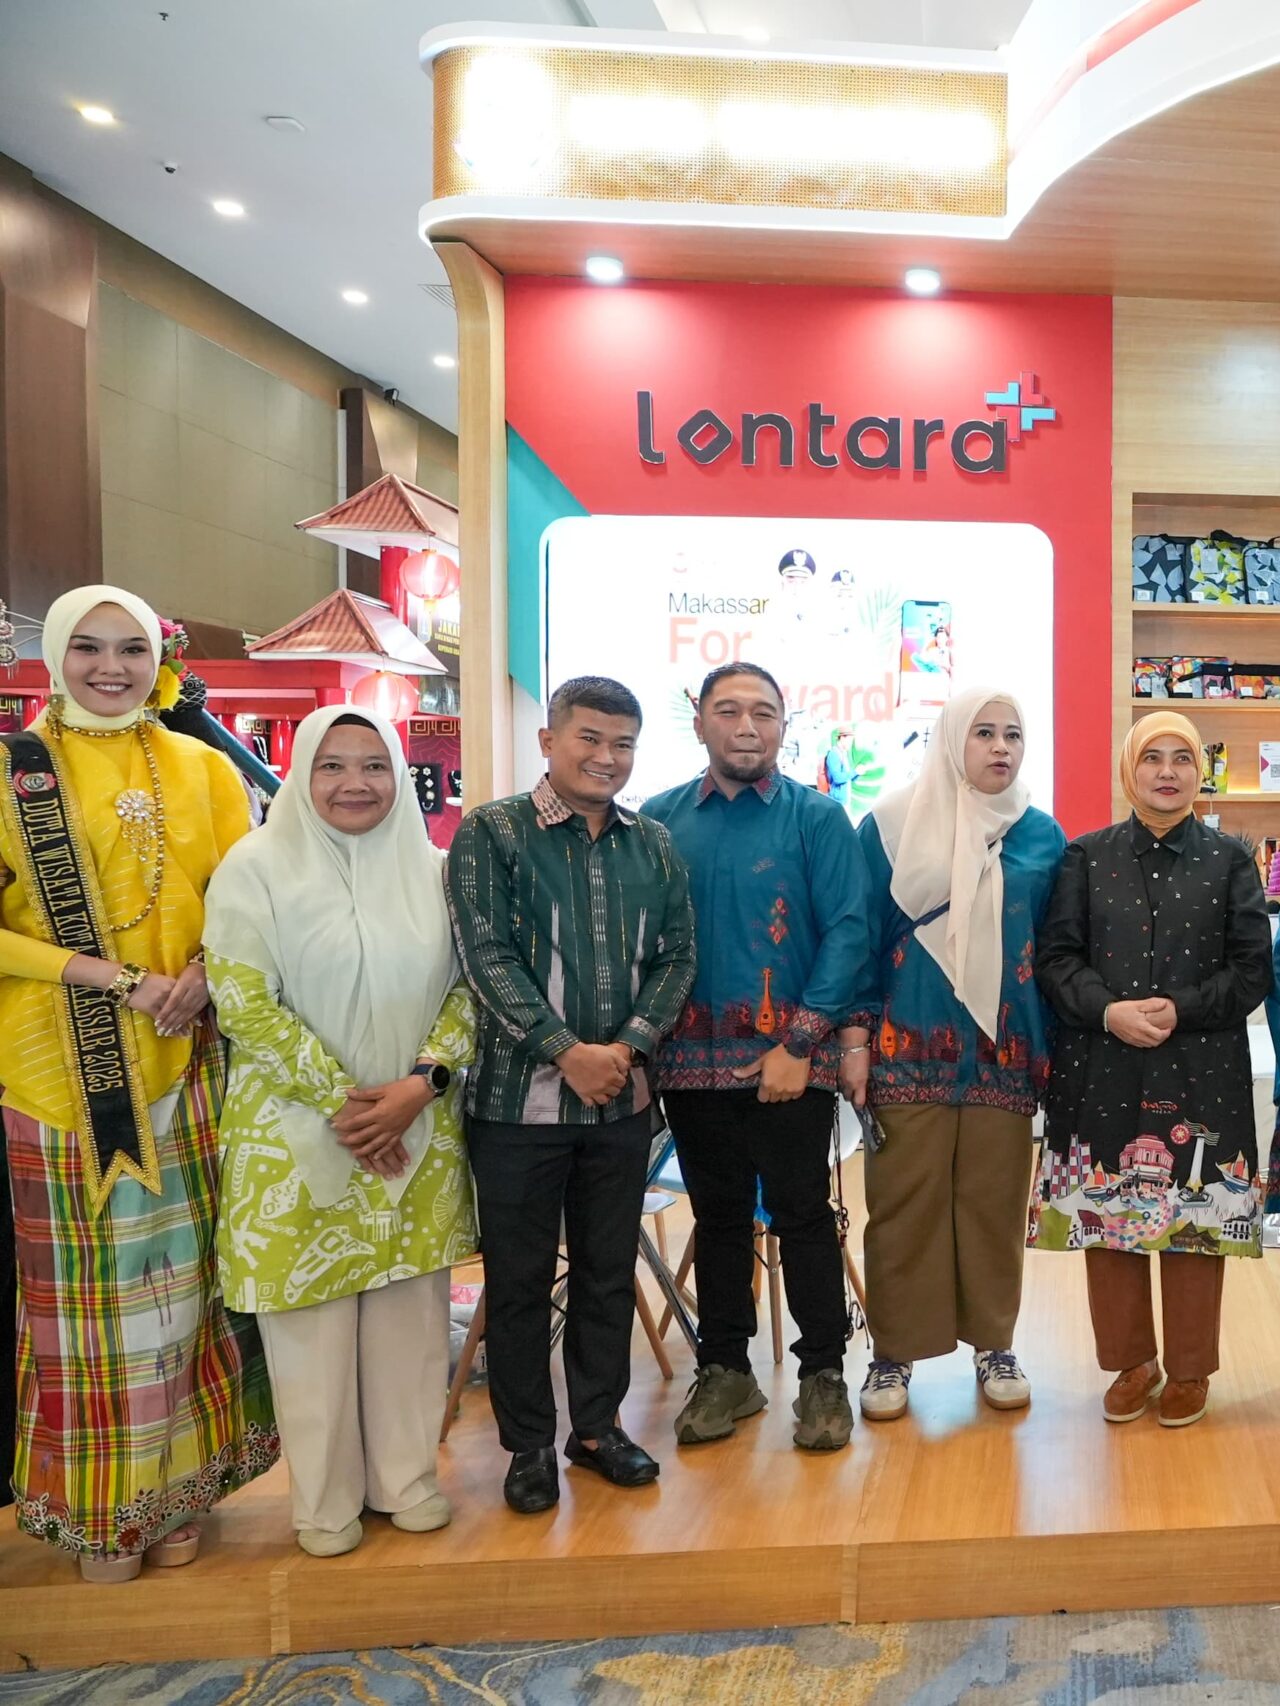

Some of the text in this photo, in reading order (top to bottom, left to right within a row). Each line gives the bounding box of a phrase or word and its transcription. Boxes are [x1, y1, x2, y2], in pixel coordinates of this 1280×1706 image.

[668, 592, 770, 614] Makassar
[668, 616, 753, 666] For
[22, 798, 65, 848] DUTA
[33, 843, 81, 913] WISATA
[71, 983, 111, 1051] KASSAR
[83, 1050, 124, 1094] 2025
